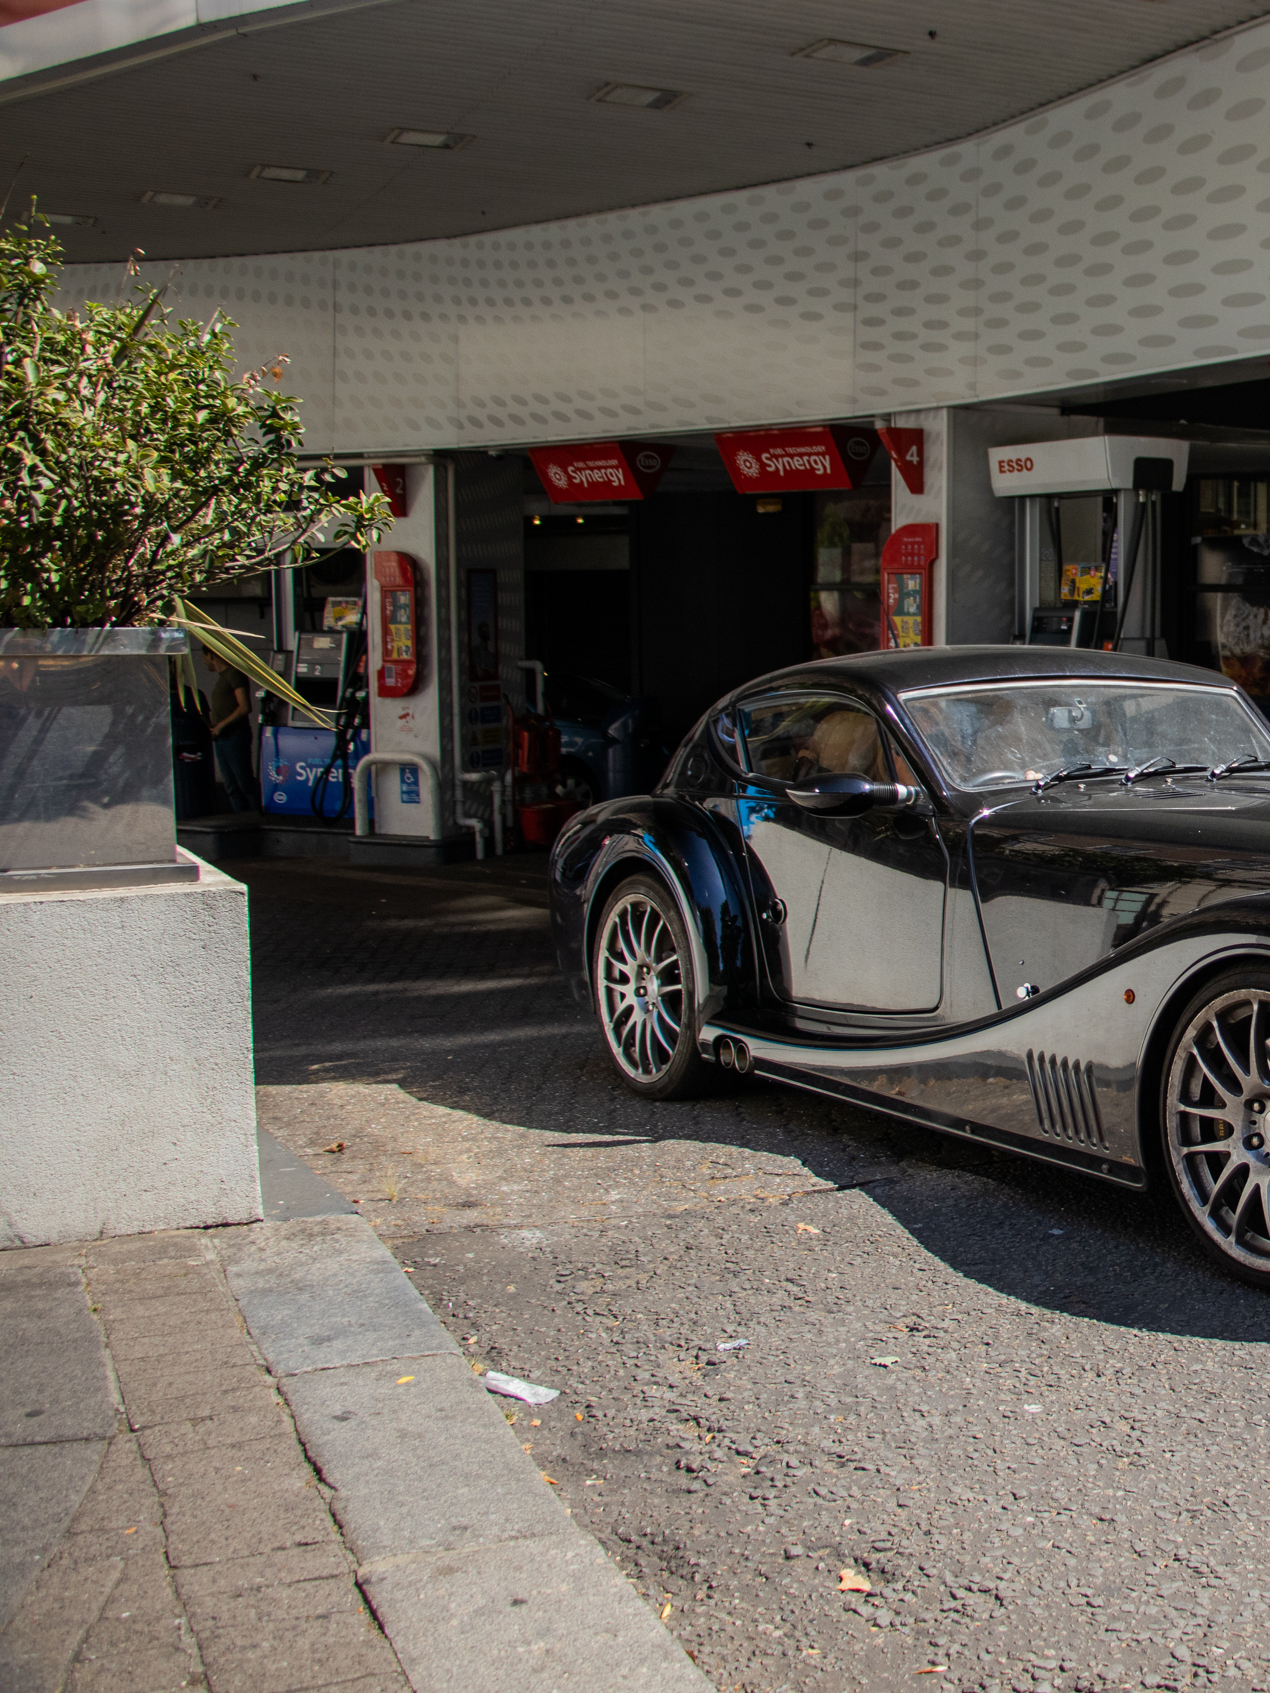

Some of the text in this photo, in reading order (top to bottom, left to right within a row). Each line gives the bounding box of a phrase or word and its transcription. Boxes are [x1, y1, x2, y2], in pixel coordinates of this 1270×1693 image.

[769, 445, 826, 455] FUEL TECHNOLOGY
[905, 445, 920, 465] 4
[760, 451, 831, 477] Synergy
[998, 457, 1034, 474] ESSO
[567, 464, 626, 488] Synergy
[395, 477, 404, 494] 2
[314, 665, 322, 675] 2
